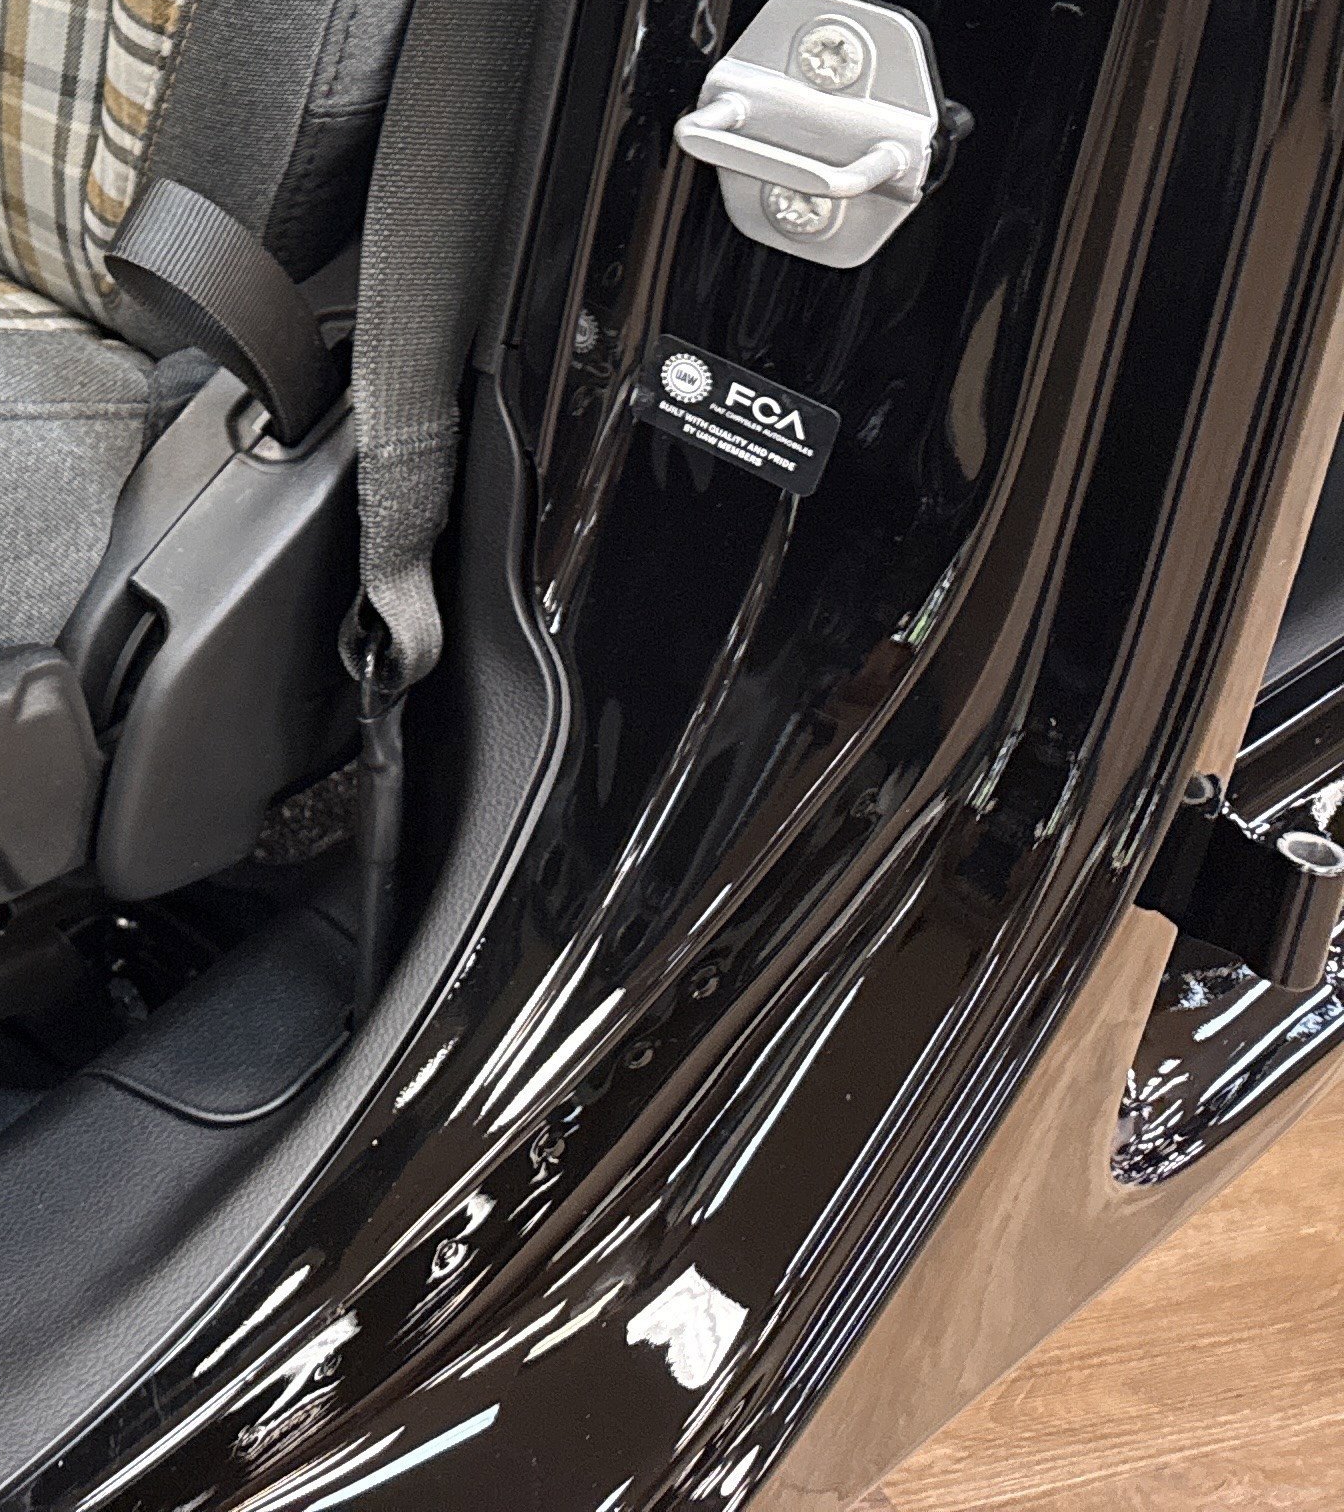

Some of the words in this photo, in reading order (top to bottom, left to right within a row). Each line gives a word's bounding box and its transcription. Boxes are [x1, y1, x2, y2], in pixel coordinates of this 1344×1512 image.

[658, 400, 685, 419] BUILT
[683, 412, 708, 430] WITH
[707, 423, 748, 448] QUALITY
[746, 442, 768, 458] AND
[767, 451, 796, 471] PRIDE
[725, 381, 805, 441] FCA
[682, 424, 695, 435] BY
[695, 430, 718, 446] UAW
[716, 440, 763, 467] MEMBERS
